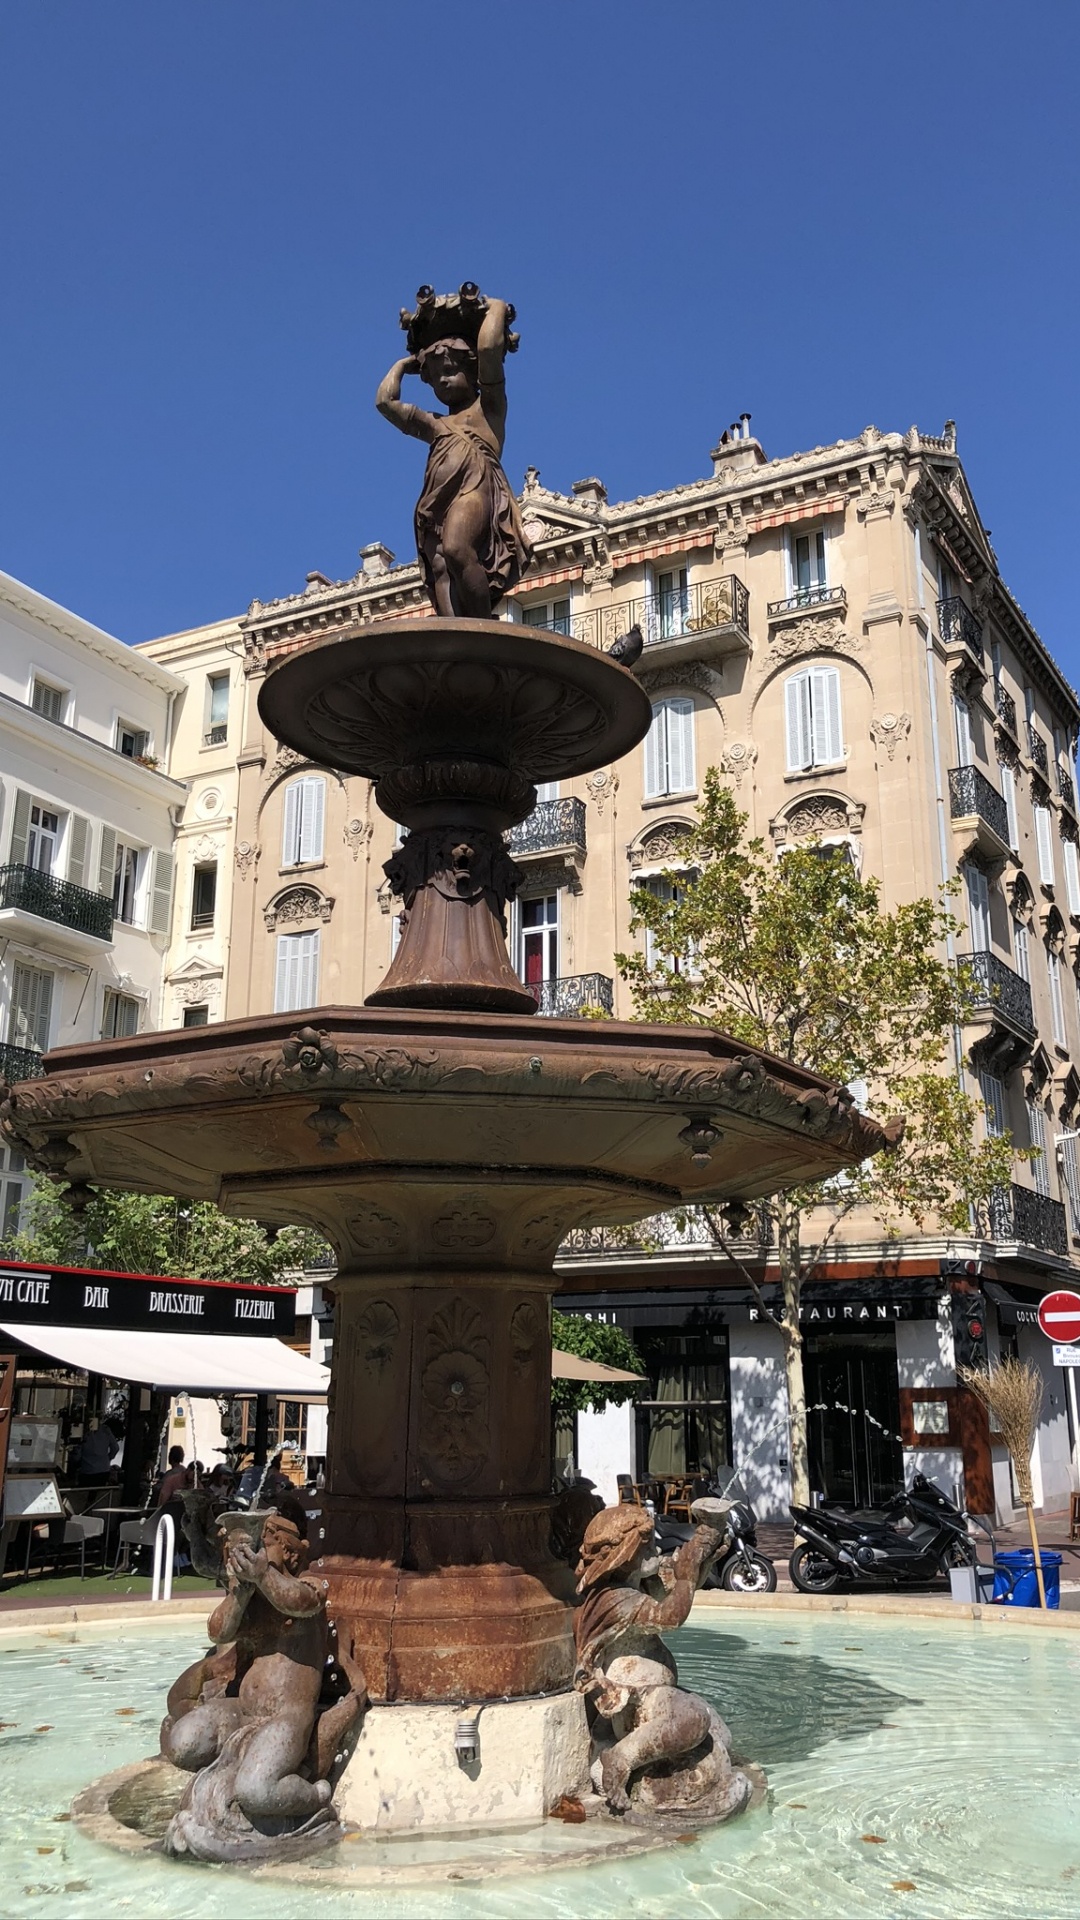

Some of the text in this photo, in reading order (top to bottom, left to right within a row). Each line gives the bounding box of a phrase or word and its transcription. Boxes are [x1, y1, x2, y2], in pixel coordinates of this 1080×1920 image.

[17, 1280, 50, 1304] CAFE
[83, 1286, 109, 1308] BAR
[149, 1291, 205, 1315] BRASSERIE
[235, 1298, 275, 1319] PIZZERIA
